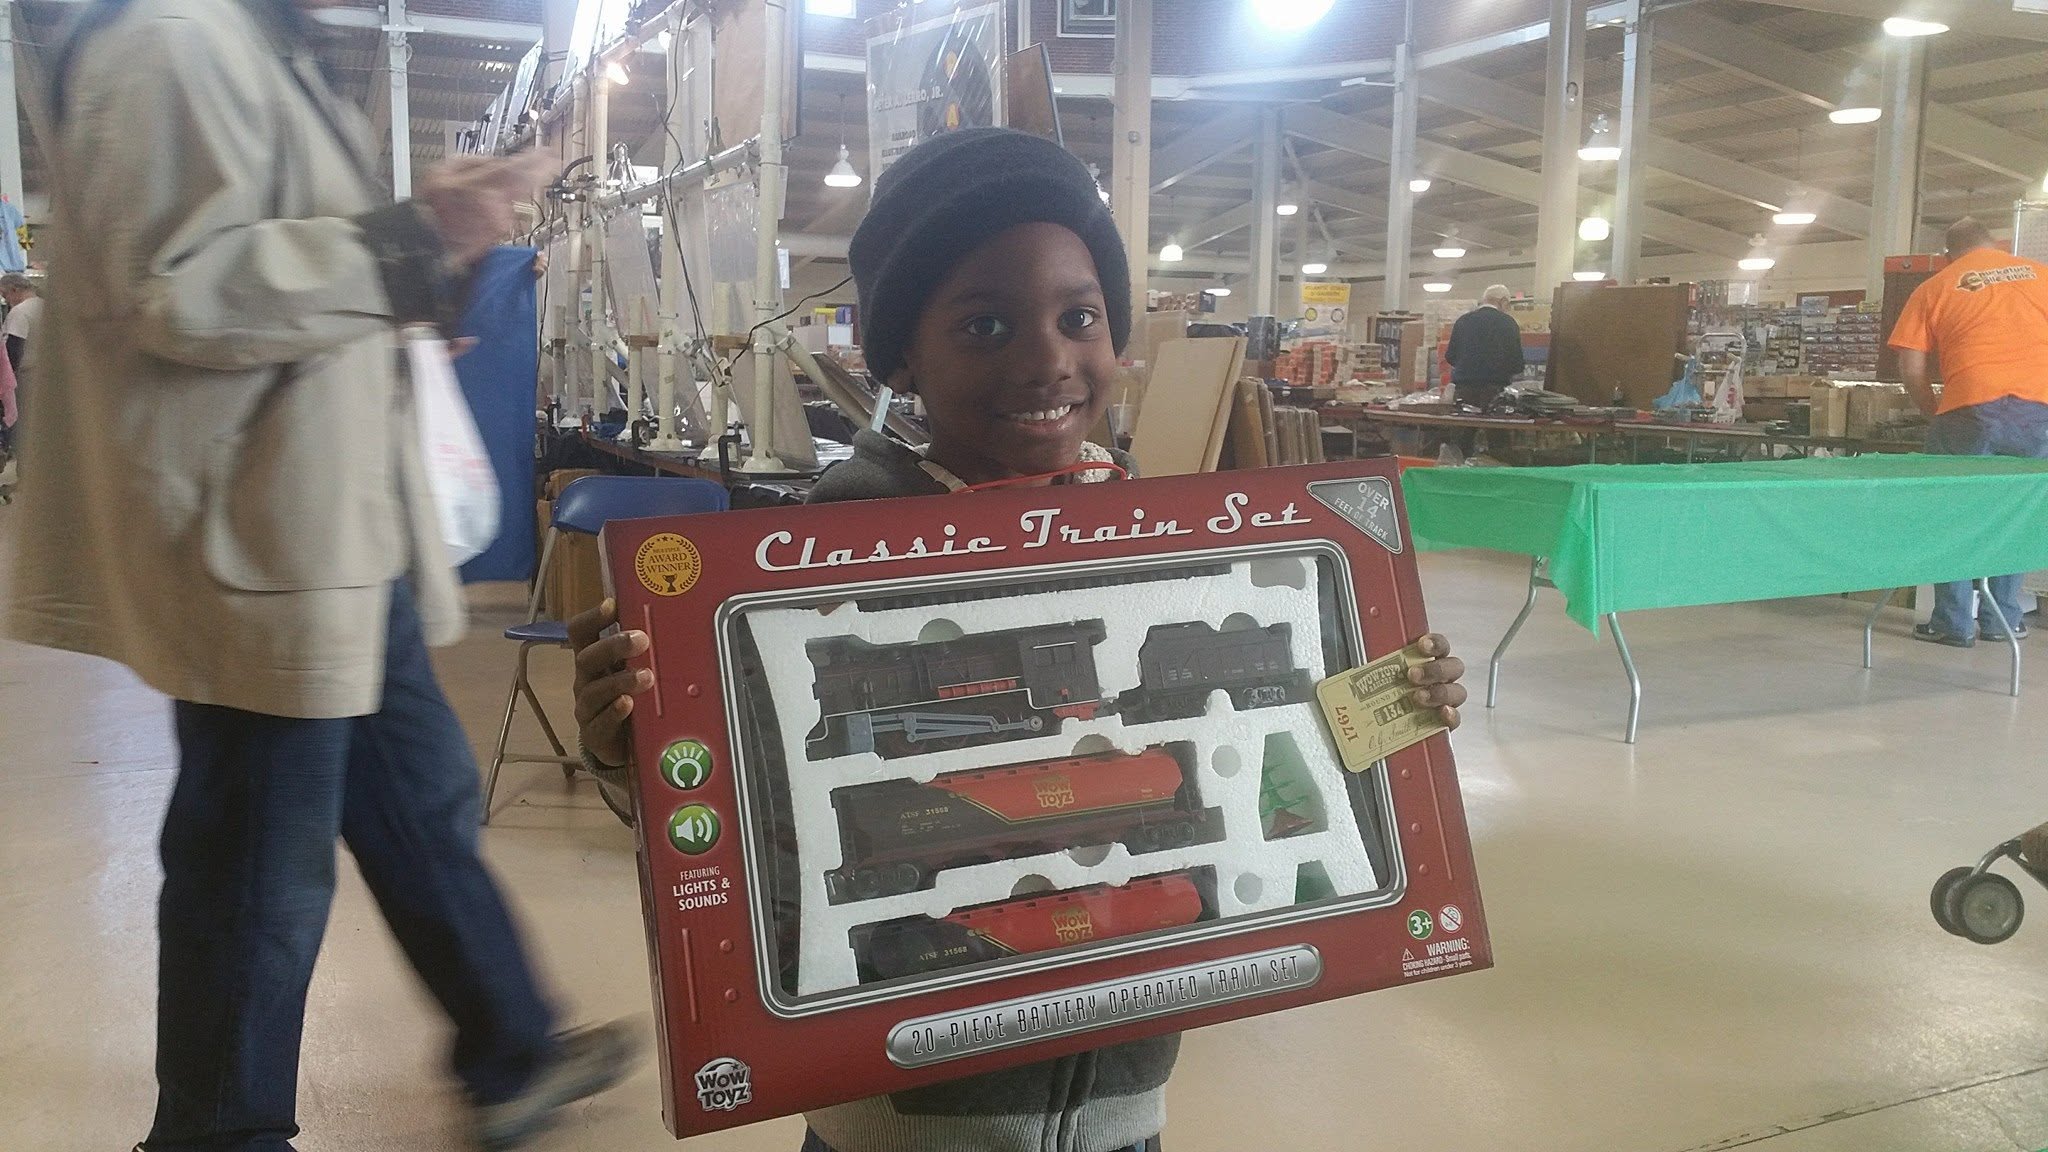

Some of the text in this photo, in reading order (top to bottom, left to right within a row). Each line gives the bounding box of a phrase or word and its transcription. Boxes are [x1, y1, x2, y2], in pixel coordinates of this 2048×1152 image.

[1357, 482, 1389, 510] OVER
[1357, 497, 1379, 519] 14
[1334, 498, 1353, 514] FEET
[1365, 519, 1389, 540] TRACK
[755, 492, 1312, 572] Classic Train Set
[648, 552, 687, 563] AWARD
[646, 562, 691, 573] WINNER
[1335, 706, 1359, 742] 1767
[1033, 780, 1071, 794] WOW
[1037, 791, 1074, 808] TOYZ
[680, 866, 720, 881] FEATURING
[672, 877, 730, 897] LIGHTS &
[678, 892, 728, 911] SOUNDS
[1053, 912, 1090, 929] WOW
[1410, 915, 1432, 935] 3+
[1057, 926, 1092, 943] TOYZ
[1426, 937, 1471, 956] WARNING:
[1402, 960, 1424, 970] CHOKING
[911, 955, 1299, 1055] 20-PIECE BATTERY OPERATED TRAIN SET
[698, 1069, 747, 1089] WOW
[701, 1085, 748, 1107] TOYZ
